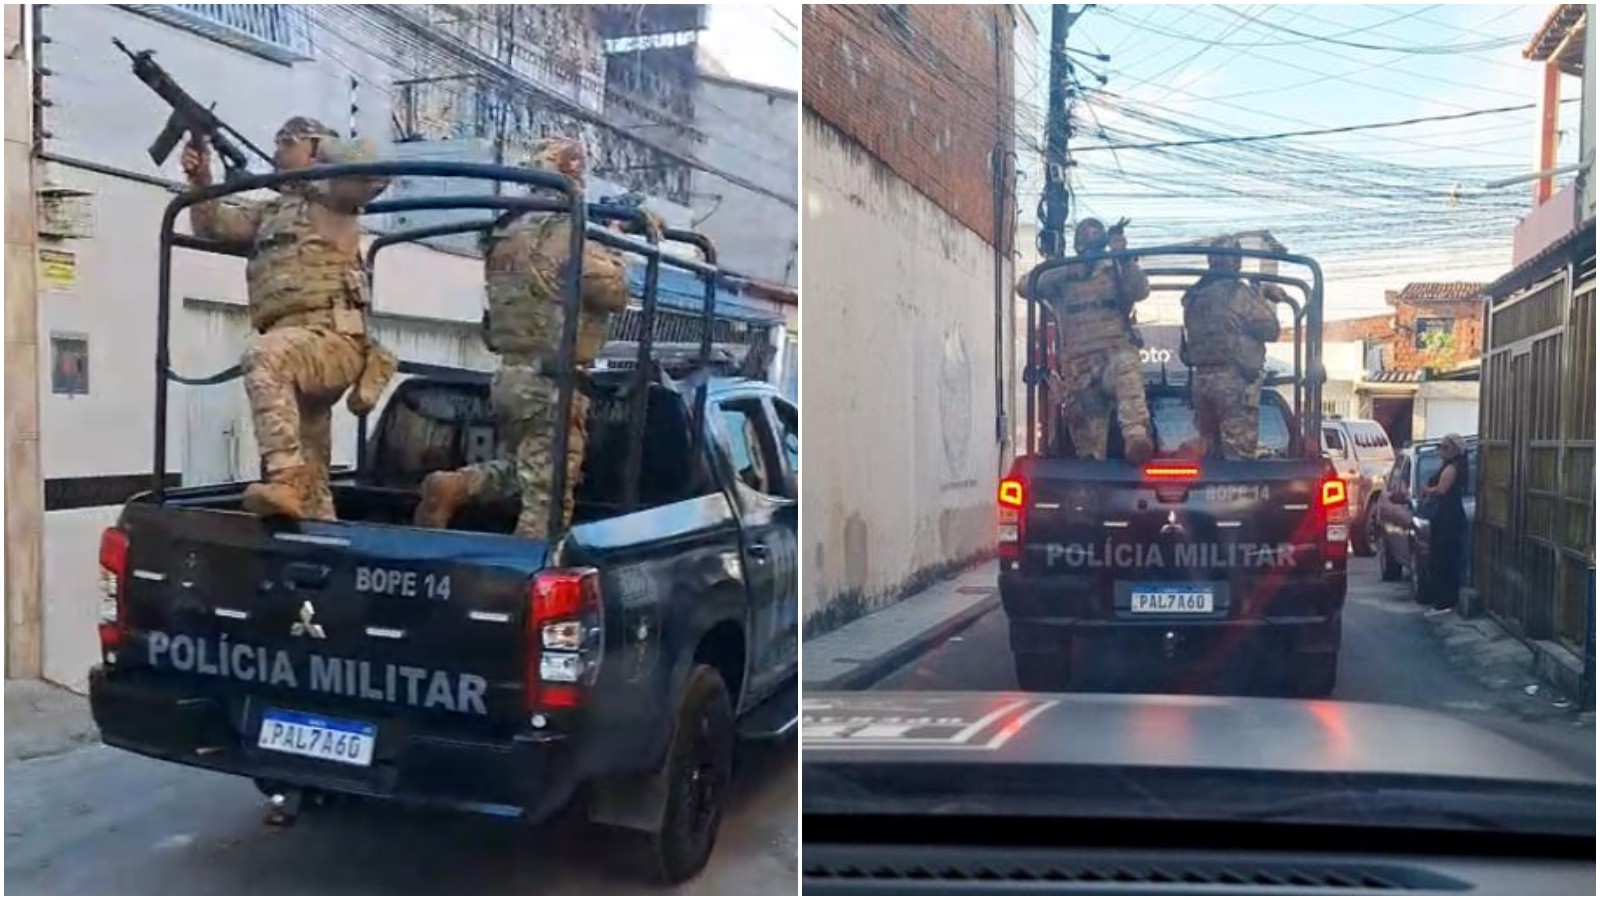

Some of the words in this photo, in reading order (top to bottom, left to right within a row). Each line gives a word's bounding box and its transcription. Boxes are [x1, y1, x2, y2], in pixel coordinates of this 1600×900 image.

[1046, 536, 1165, 567] POLÍCIA
[1175, 542, 1297, 567] MILITAR
[356, 566, 416, 597] BOPE
[424, 573, 451, 600] 14
[148, 630, 298, 688] POLÍCIA
[309, 653, 488, 715] MILITAR
[270, 722, 362, 759] PAL7A60
